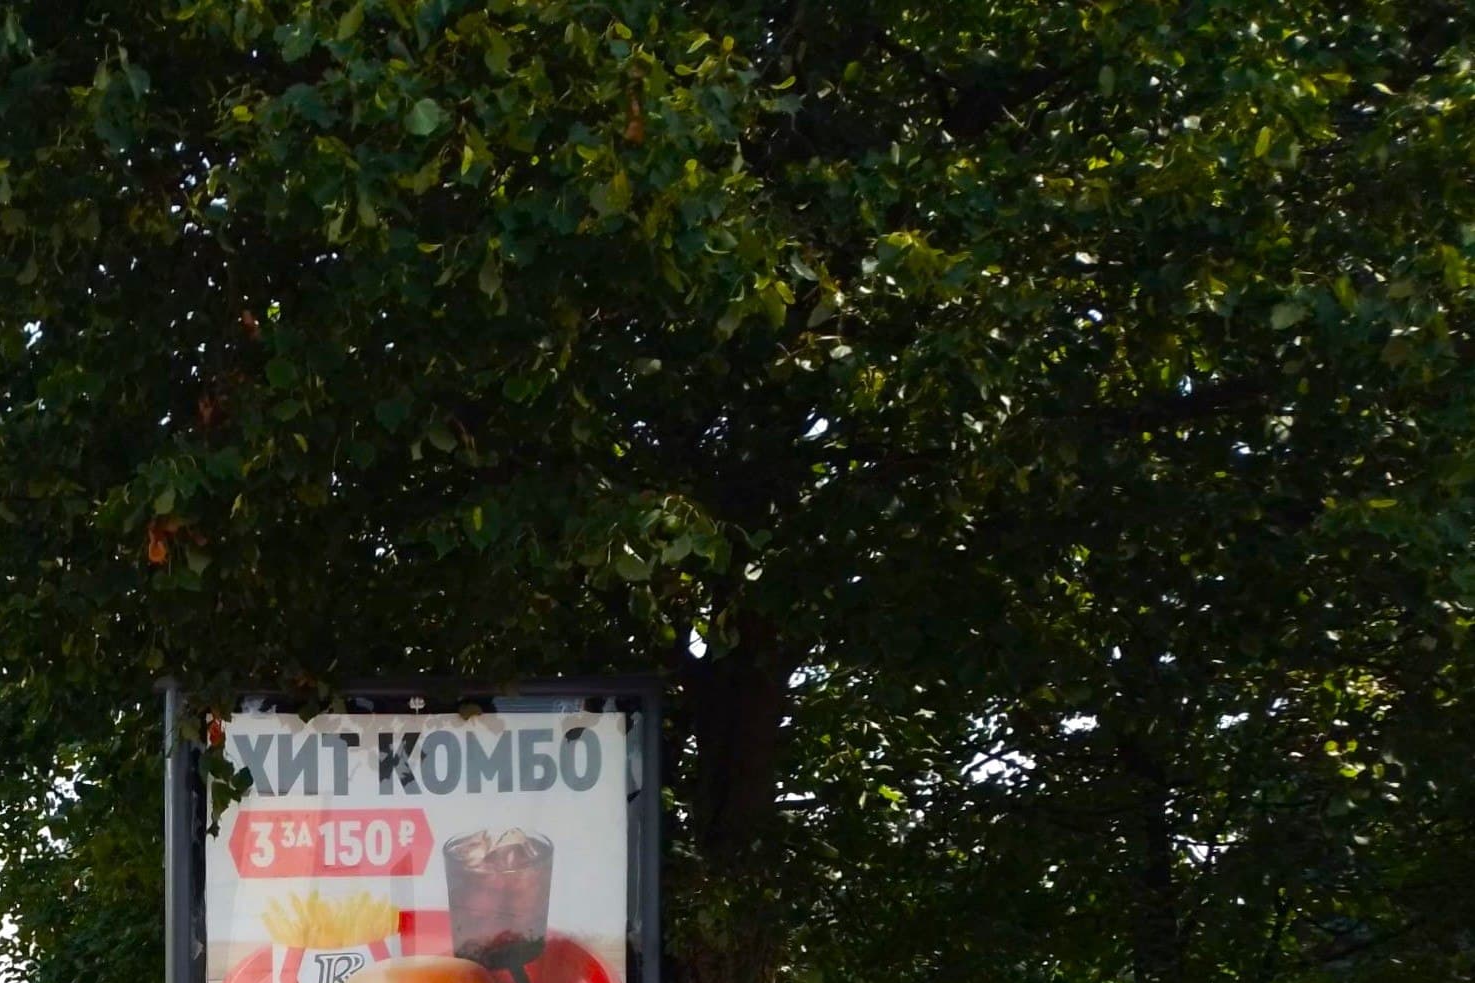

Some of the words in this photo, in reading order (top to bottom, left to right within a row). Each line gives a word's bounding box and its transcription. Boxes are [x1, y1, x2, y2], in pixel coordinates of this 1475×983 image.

[232, 731, 358, 797] ХИТ
[379, 727, 602, 796] КОМБО
[250, 822, 275, 867] 3
